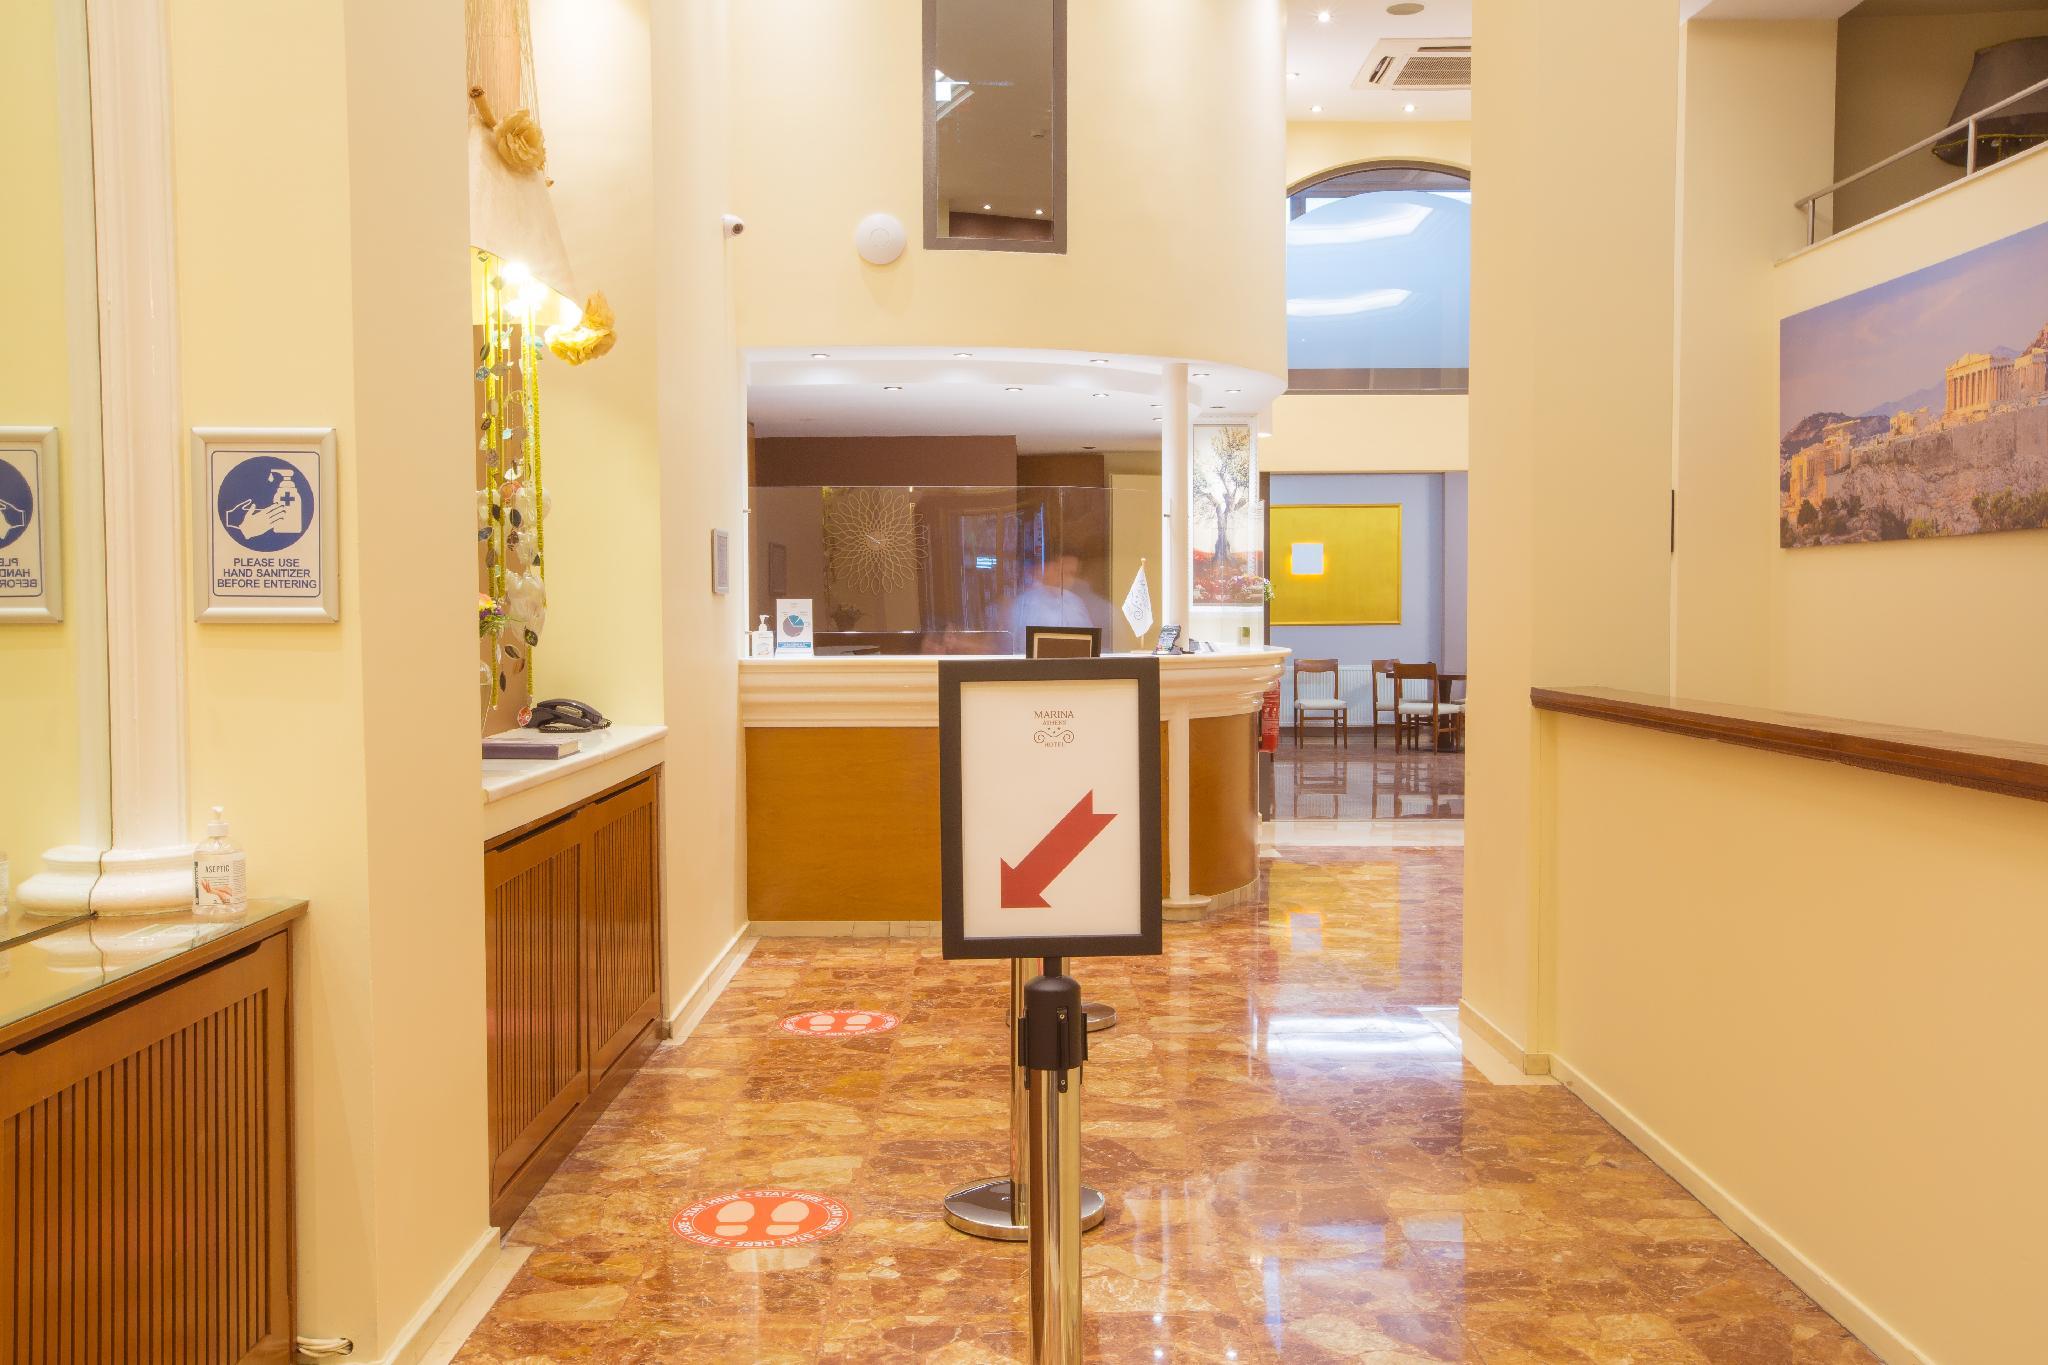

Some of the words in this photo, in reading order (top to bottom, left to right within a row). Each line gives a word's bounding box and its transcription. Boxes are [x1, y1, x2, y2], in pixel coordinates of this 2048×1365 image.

[233, 558, 274, 567] PLEASE
[278, 558, 300, 567] USE
[223, 568, 253, 577] HAND
[256, 568, 311, 578] SANITIZER
[217, 579, 260, 588] BEFORE
[263, 579, 317, 589] ENTERING
[1034, 710, 1074, 718] MARINA
[205, 865, 230, 873] ASEPTIC
